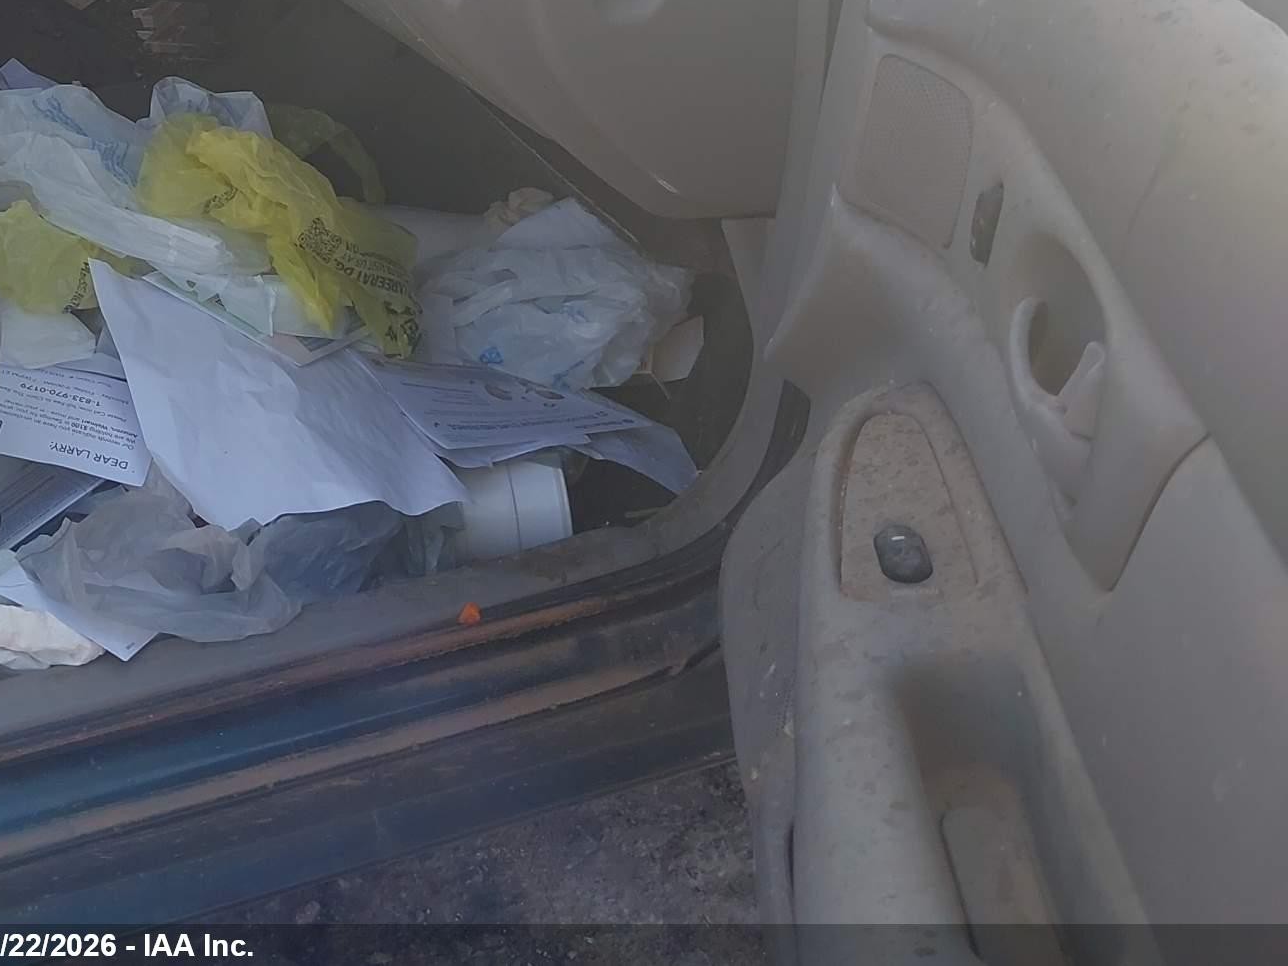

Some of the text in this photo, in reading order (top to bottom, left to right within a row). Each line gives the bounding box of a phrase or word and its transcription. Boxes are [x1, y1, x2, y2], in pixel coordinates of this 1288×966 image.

[19, 383, 103, 407] 1-833-970-0179
[80, 418, 108, 430] Walmart
[49, 440, 129, 470] DEAR LARRY:
